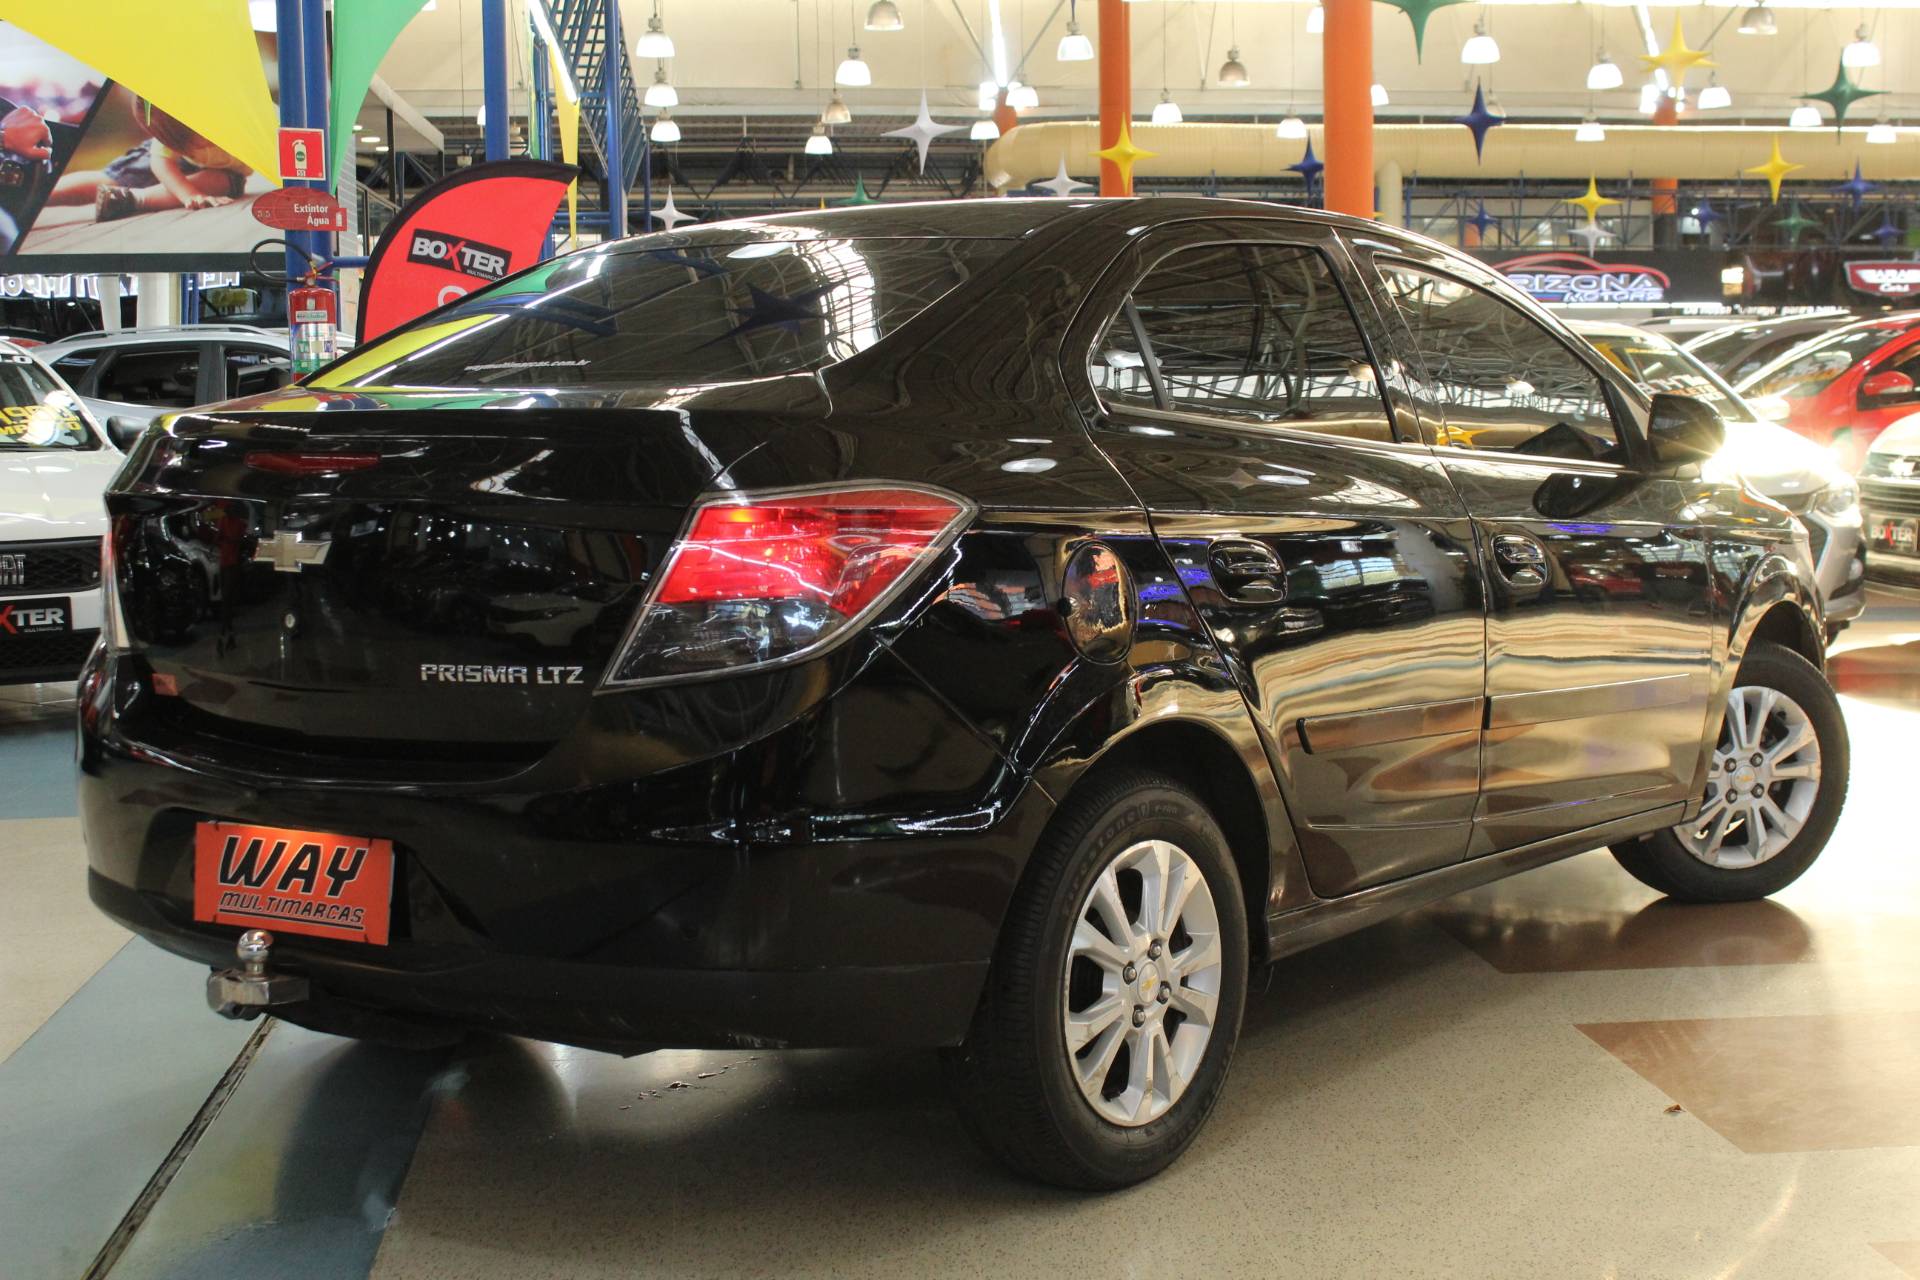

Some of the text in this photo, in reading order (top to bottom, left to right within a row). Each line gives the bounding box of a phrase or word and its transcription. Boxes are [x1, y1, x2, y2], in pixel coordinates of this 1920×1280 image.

[294, 204, 328, 213] Extintor
[307, 214, 330, 227] Água
[412, 237, 505, 276] BOXTER
[1506, 273, 1664, 292] RIZONA
[1870, 521, 1913, 545] BOXTER
[0, 555, 26, 585] AT
[421, 664, 584, 684] PRISMA LTZ
[218, 835, 369, 899] WAY
[220, 891, 364, 924] MULTIMARCAS
